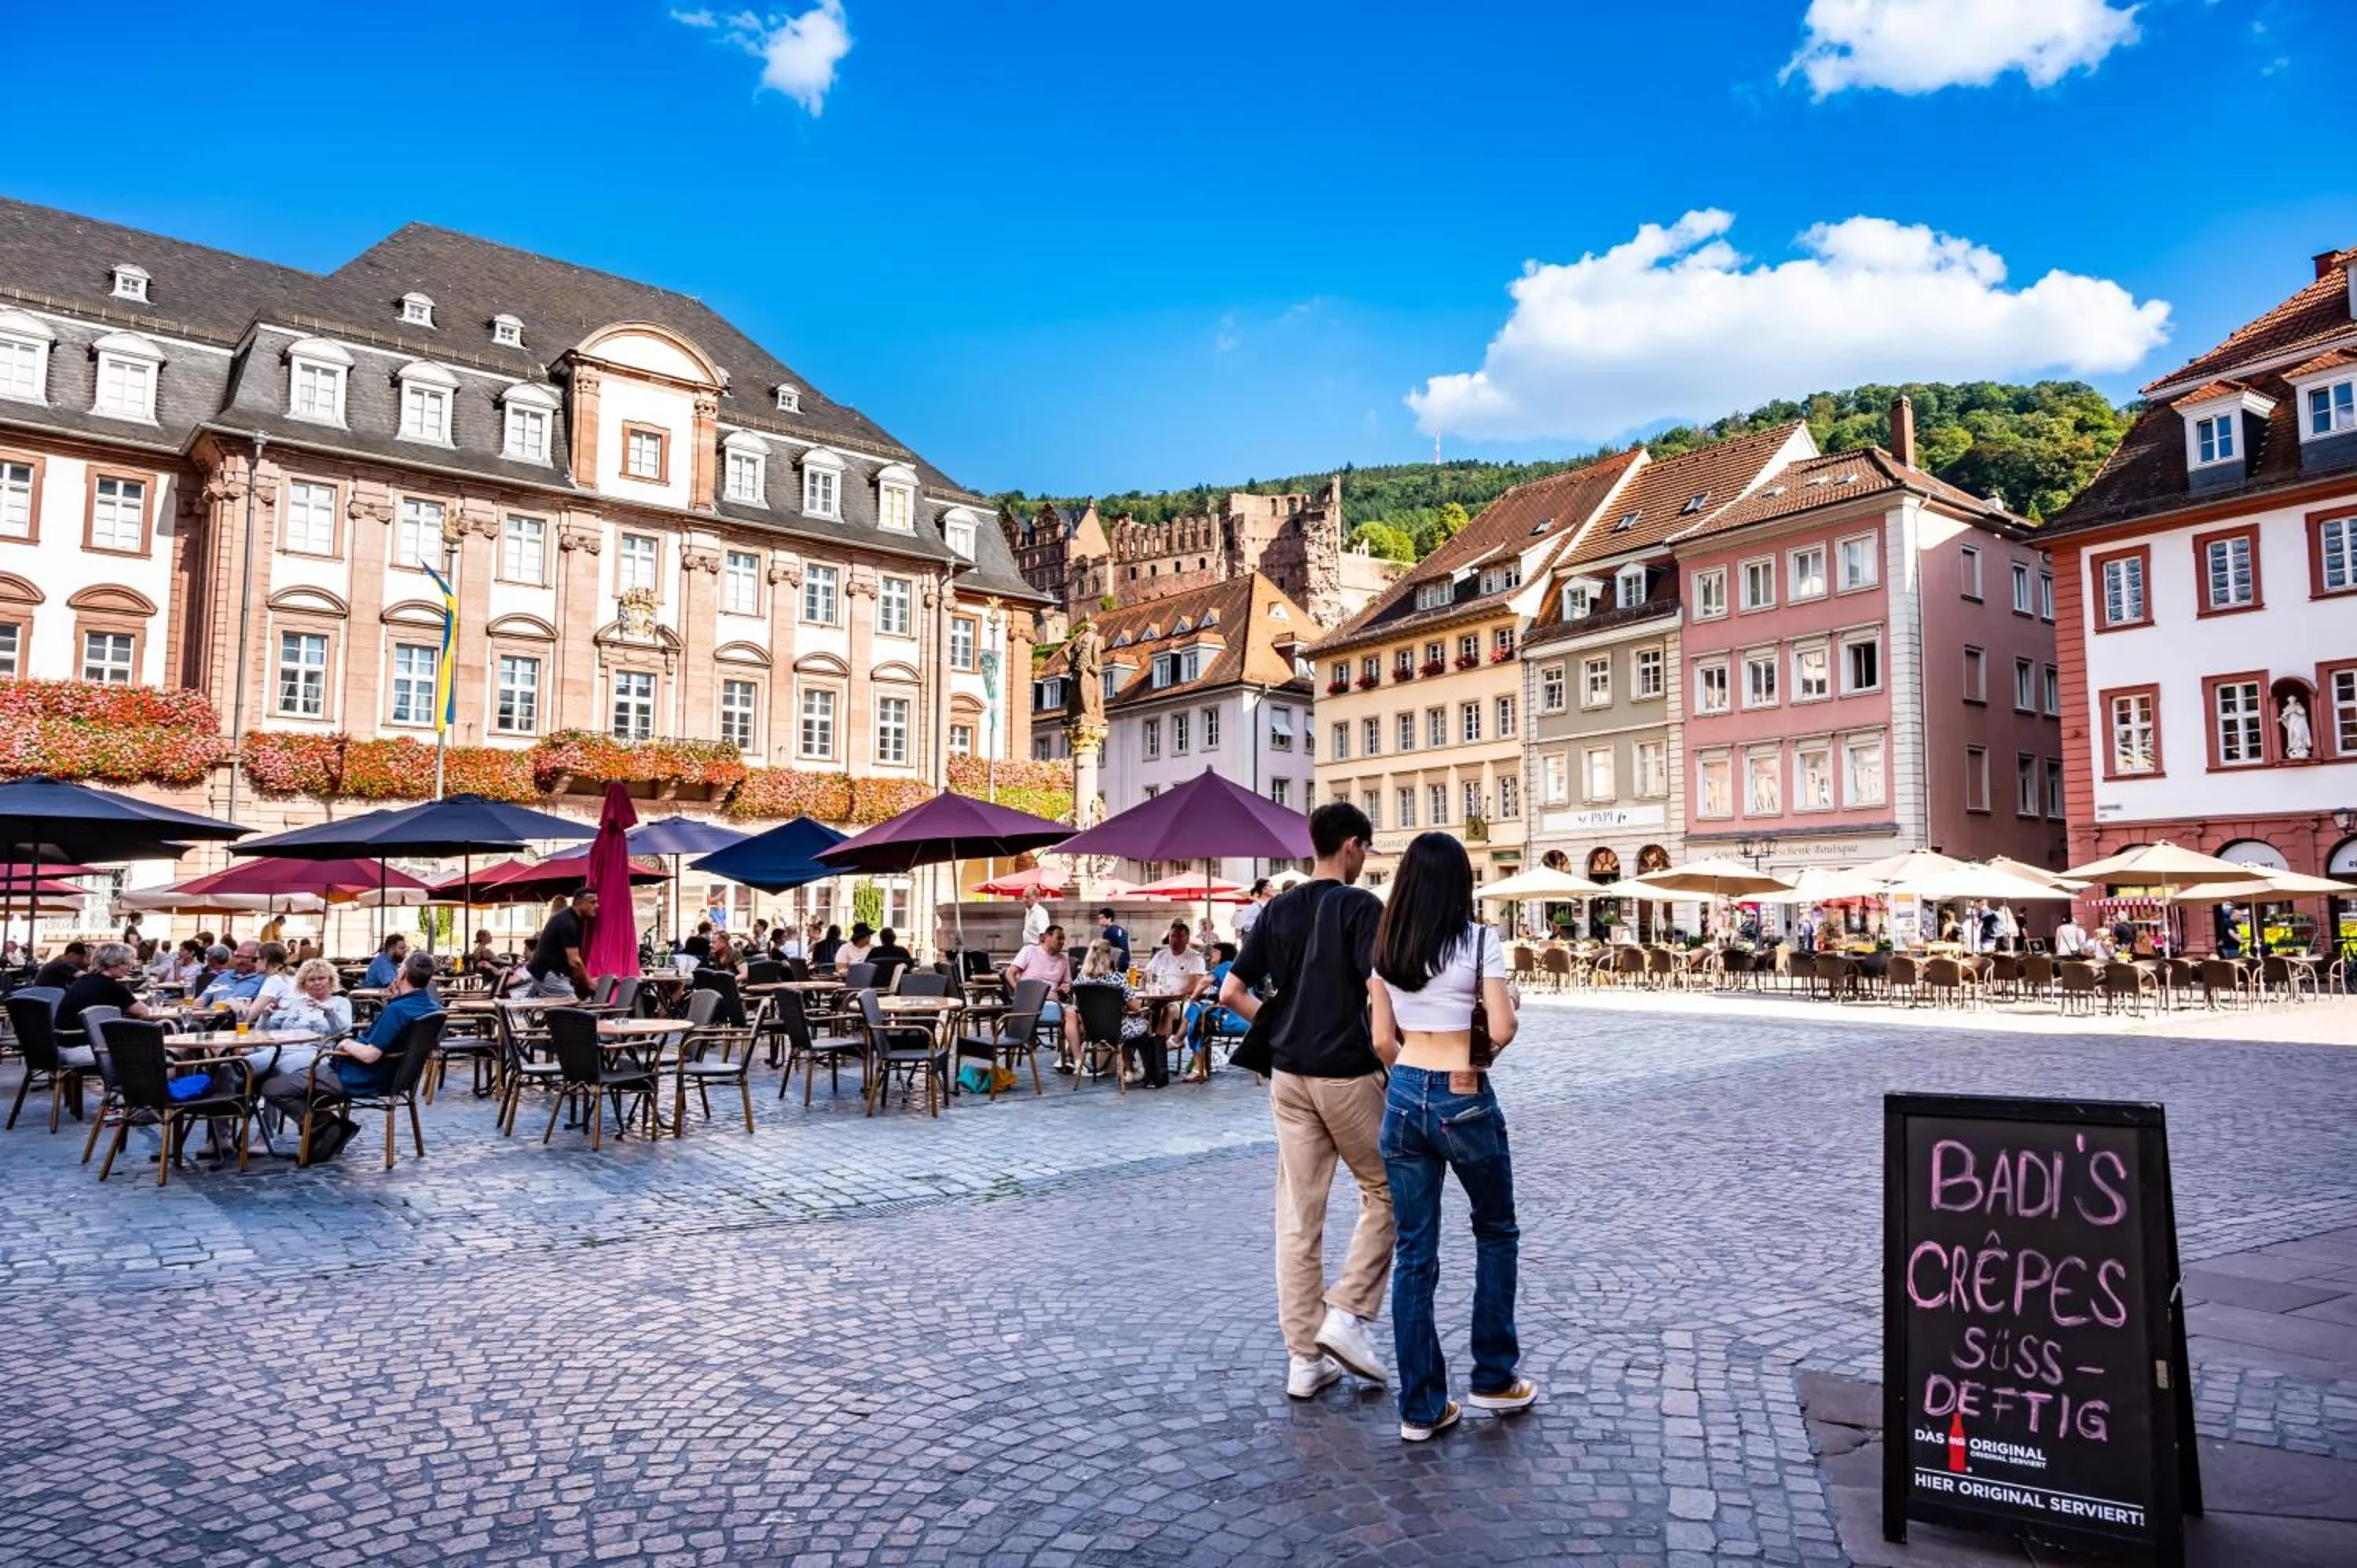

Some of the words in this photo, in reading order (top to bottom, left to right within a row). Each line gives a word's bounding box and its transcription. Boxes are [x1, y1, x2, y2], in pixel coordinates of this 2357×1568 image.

[1931, 1133, 2127, 1225] BADI'S
[1906, 1229, 2128, 1328] CRÊPES
[1924, 1372, 2109, 1441] DEFTIG
[1915, 1429, 1945, 1444] DAS
[1970, 1438, 2047, 1461] ORIGINAL
[1970, 1451, 2007, 1463] ORIGINAL
[2009, 1456, 2047, 1469] SERVIERT
[1915, 1473, 1954, 1492] HIER
[1959, 1482, 2045, 1509] ORIGINAL
[2050, 1497, 2146, 1526] SERVIERT!
